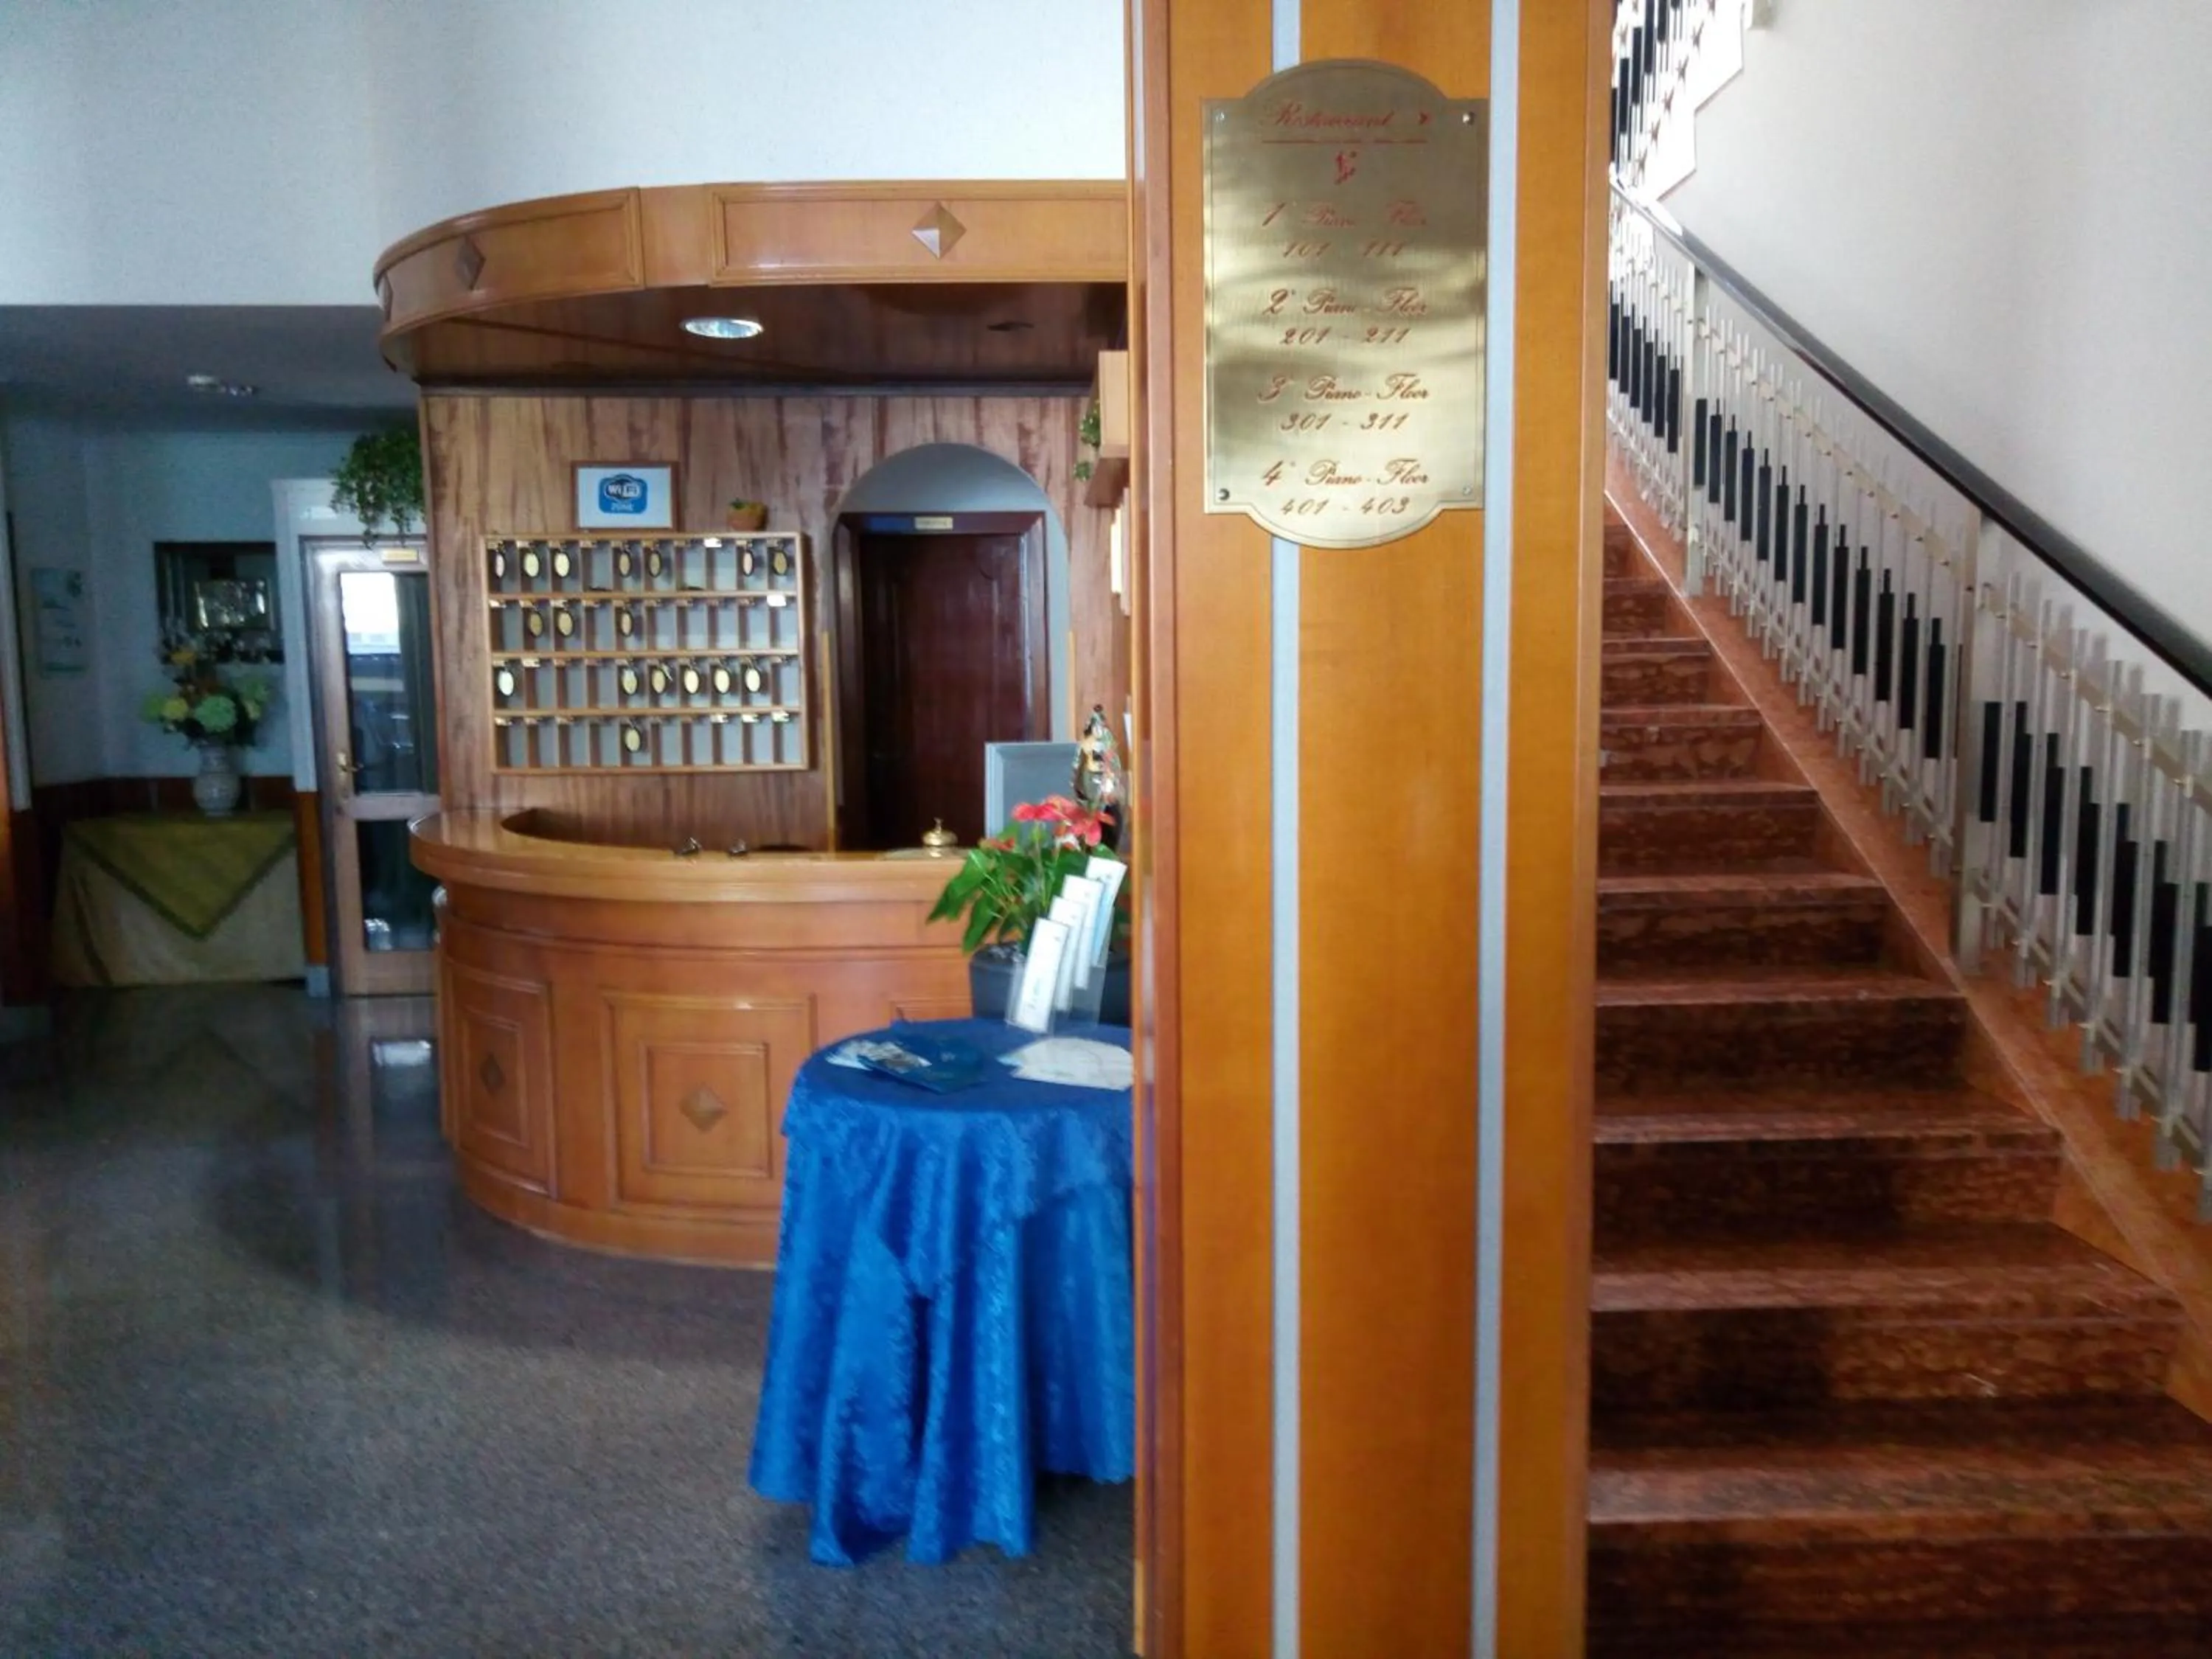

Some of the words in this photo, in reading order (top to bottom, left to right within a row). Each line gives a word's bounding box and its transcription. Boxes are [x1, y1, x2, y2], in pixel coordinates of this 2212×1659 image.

[1303, 287, 1358, 314] Piano
[1376, 287, 1427, 315] Floor
[1280, 327, 1331, 344] 201
[1363, 327, 1411, 344] 211
[1304, 374, 1362, 400] Piano
[1376, 372, 1429, 400] Floor
[1281, 412, 1332, 431] 301
[1360, 412, 1409, 430] 311
[1304, 459, 1362, 485] Piano
[1376, 458, 1429, 485] Floor
[1281, 498, 1329, 515] 401
[1361, 496, 1410, 515] 403
